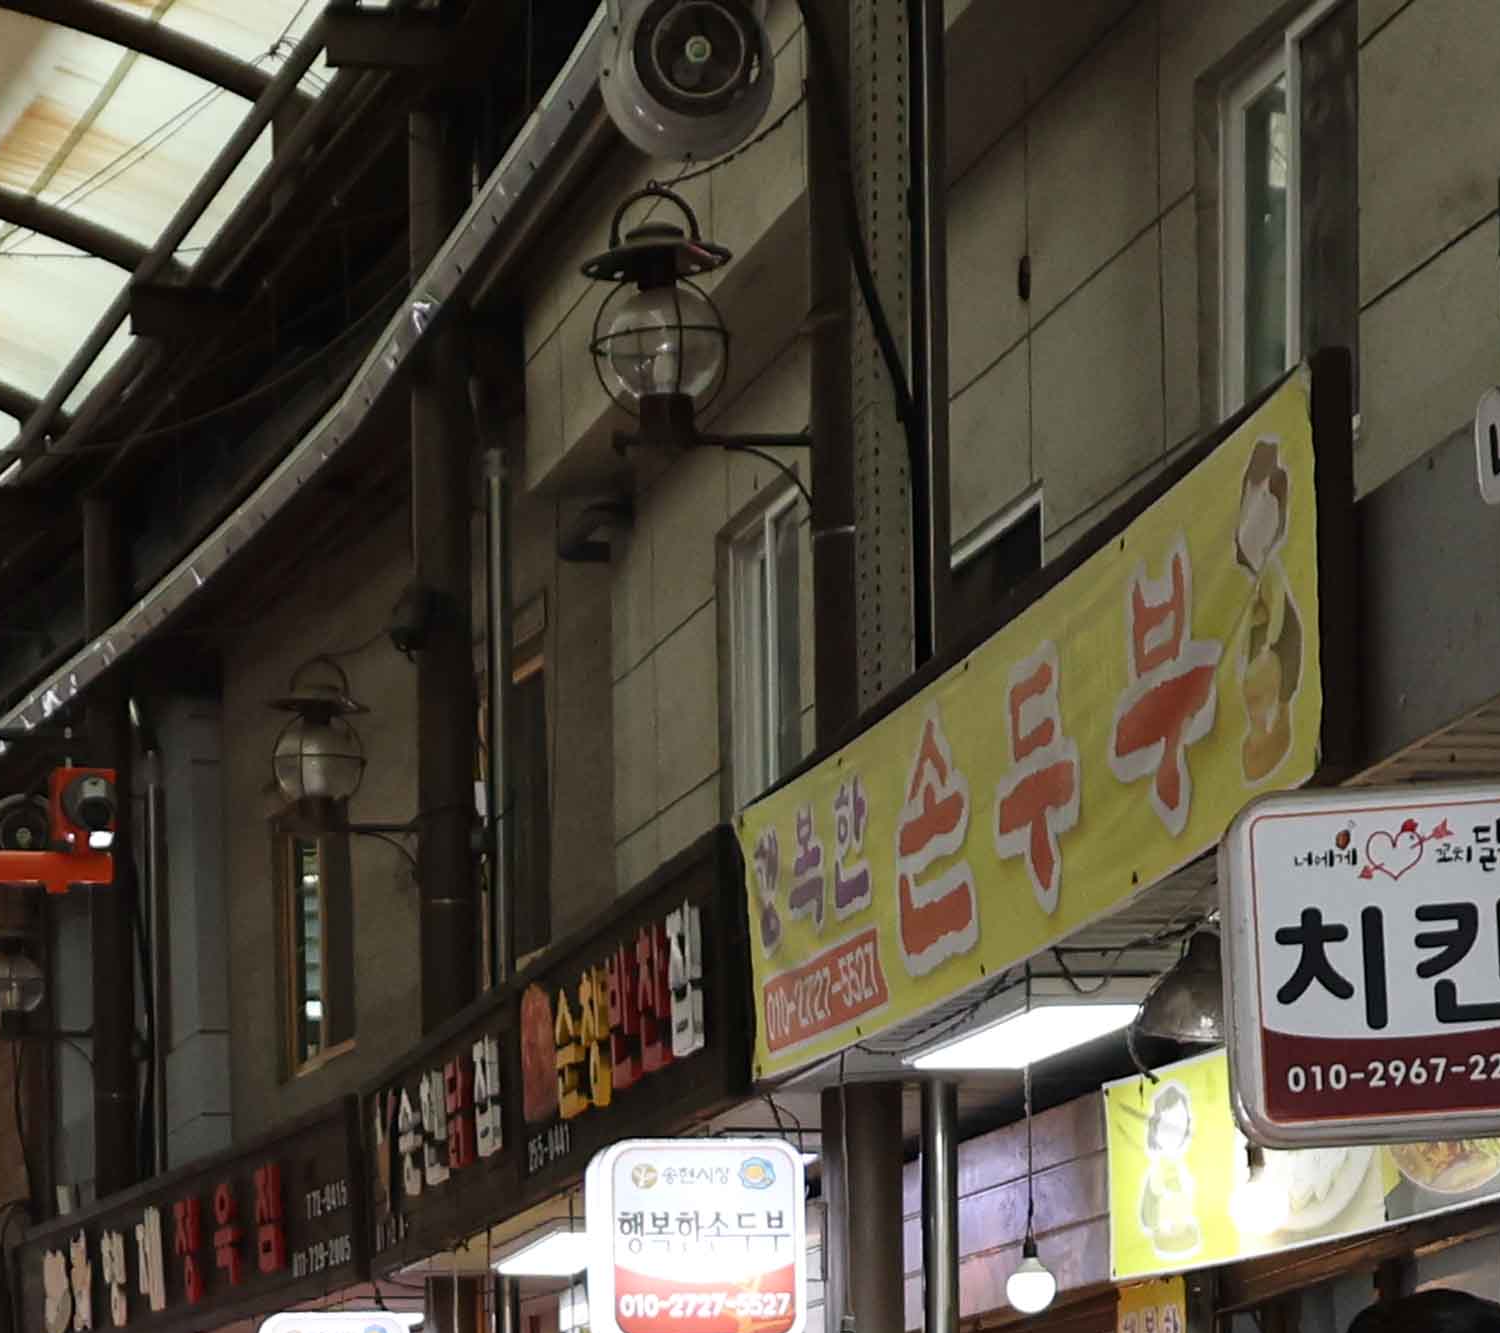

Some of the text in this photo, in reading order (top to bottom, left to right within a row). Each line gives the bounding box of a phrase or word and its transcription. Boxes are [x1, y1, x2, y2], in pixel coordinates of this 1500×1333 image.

[896, 528, 1220, 979] 손두부
[753, 781, 873, 953] 행복한
[1292, 845, 1358, 869] 너에게
[555, 896, 704, 1120] 순창반찬집
[765, 937, 884, 1043] 010-2727-5527
[398, 1032, 502, 1196] 송현닭집
[661, 1166, 731, 1185] 송현시장
[620, 1293, 790, 1319] 010-2727-5527
